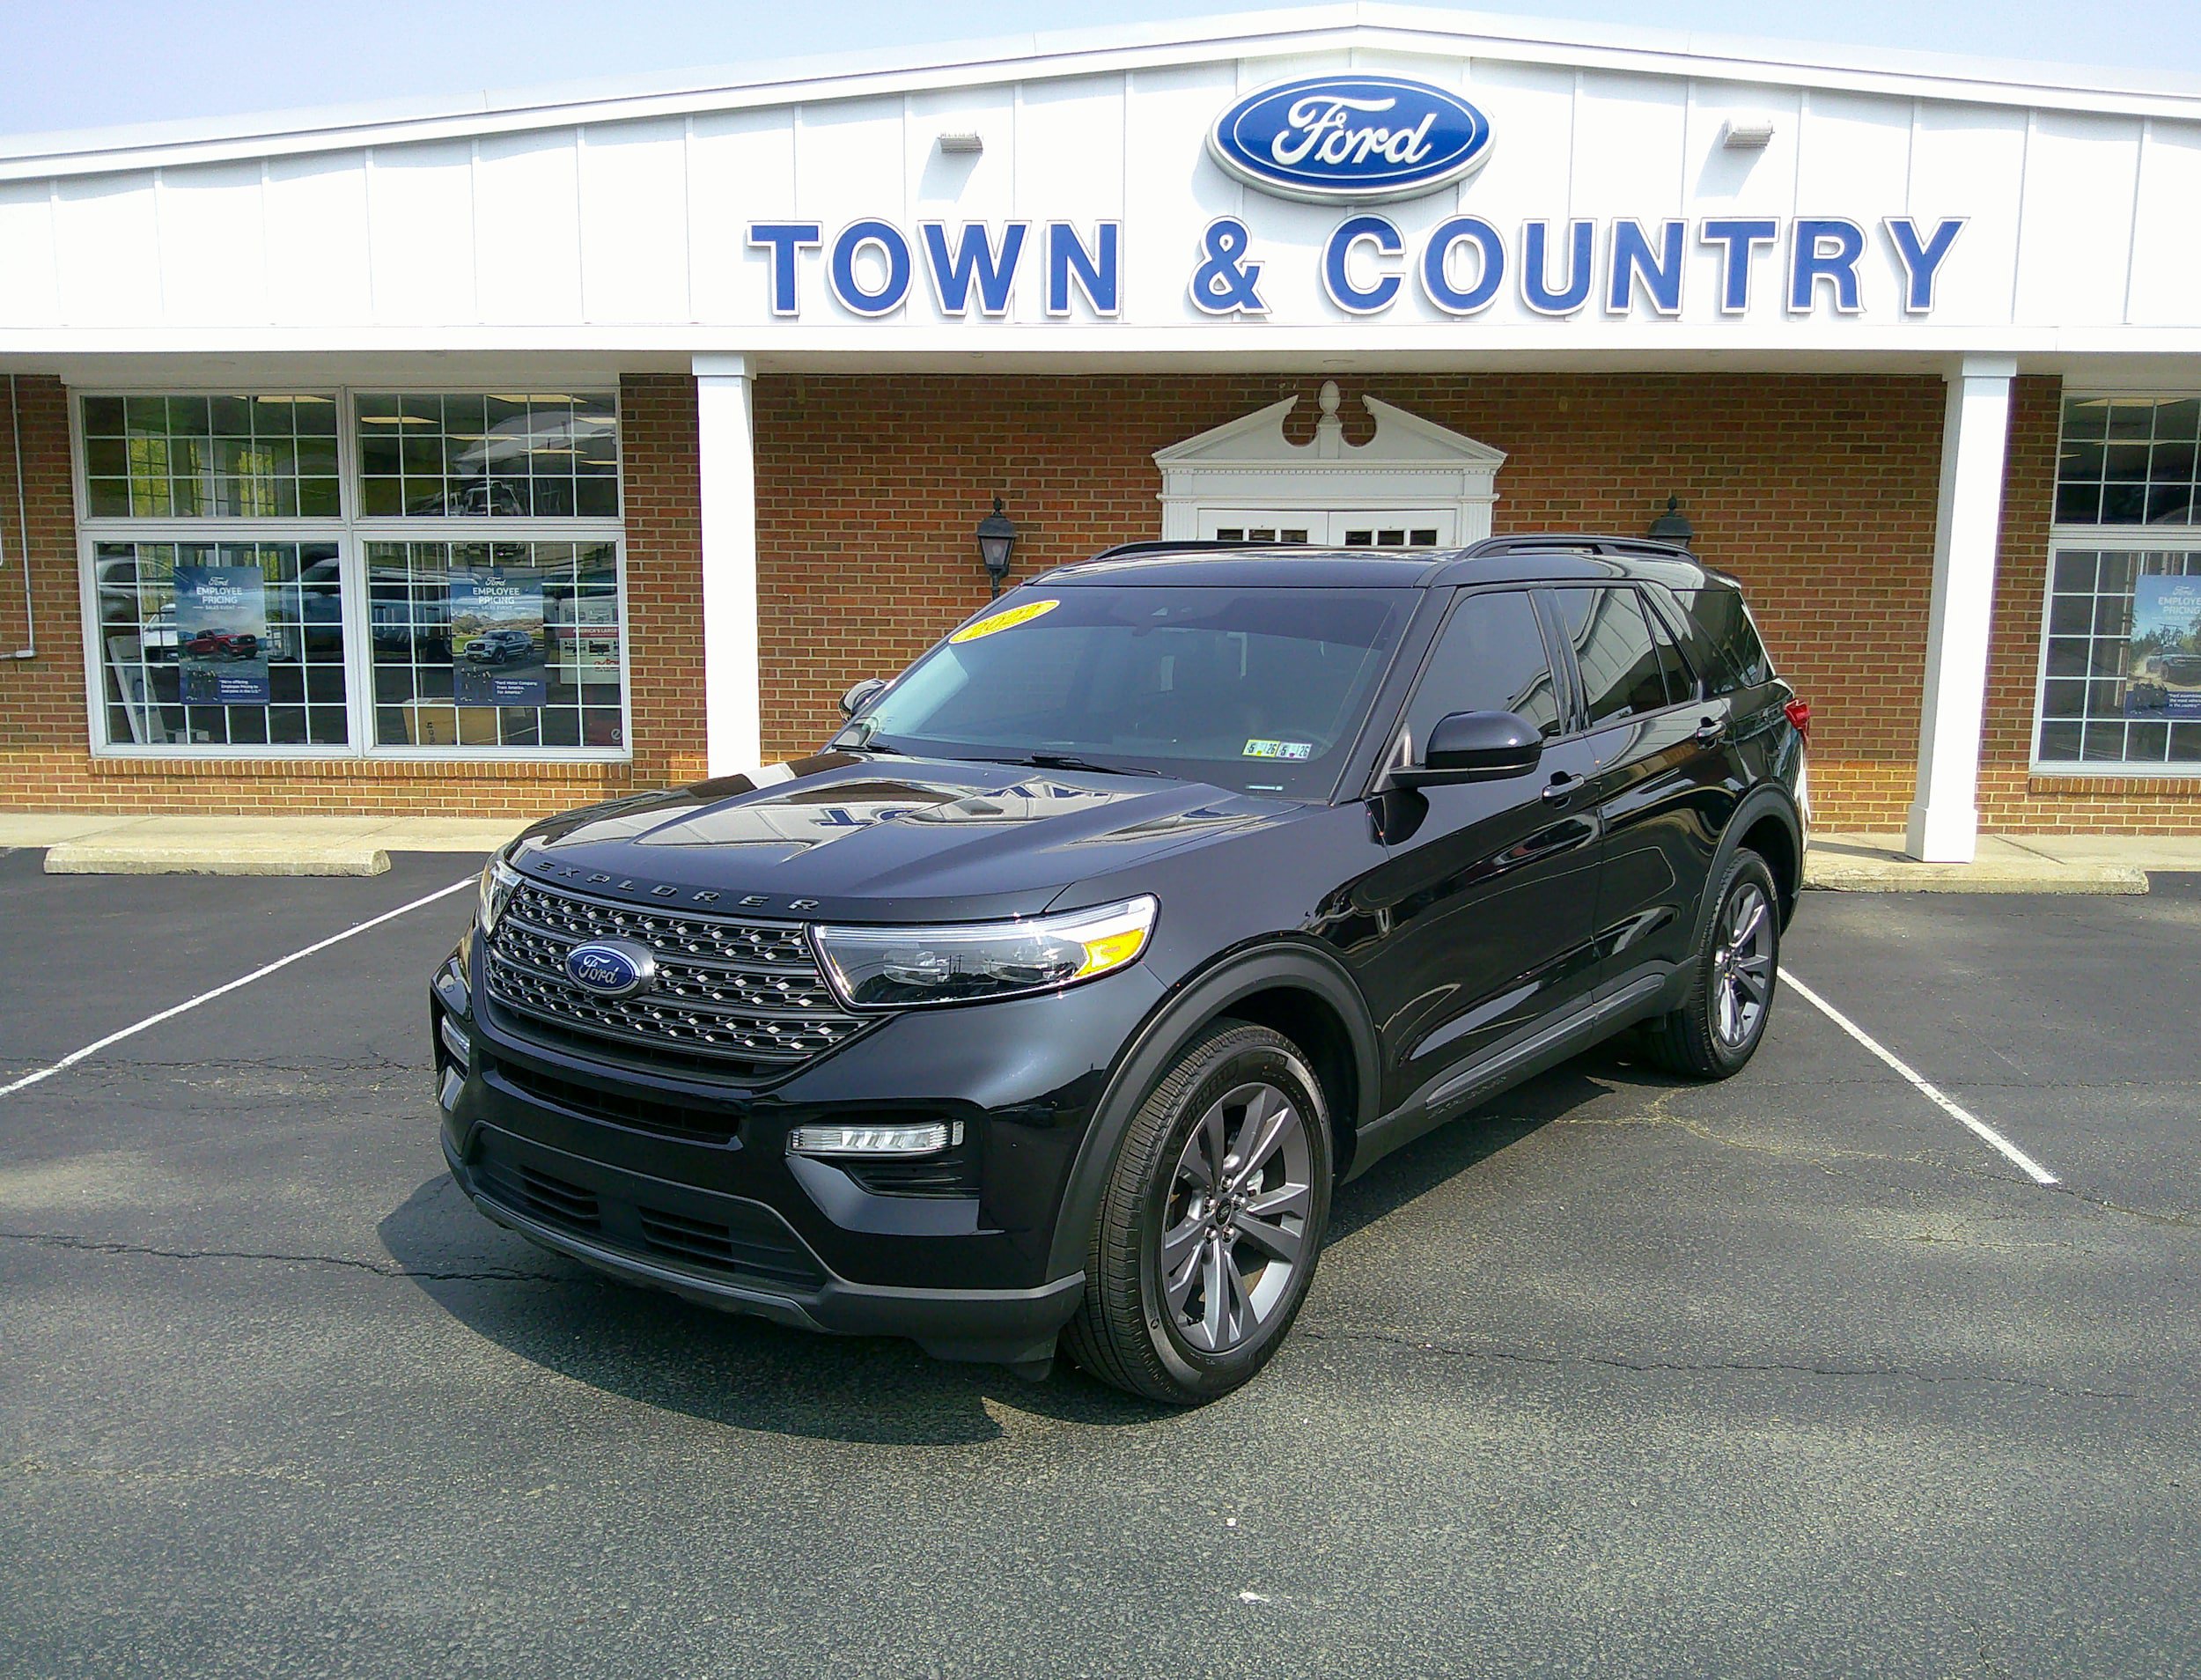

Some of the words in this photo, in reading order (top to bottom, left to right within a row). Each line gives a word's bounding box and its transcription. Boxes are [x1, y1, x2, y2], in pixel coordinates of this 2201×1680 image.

[1271, 95, 1437, 166] Ford
[747, 217, 1123, 317] TOWN
[1189, 214, 1273, 316] &
[1321, 212, 1971, 317] COUNTRY
[208, 576, 229, 586] Ford
[485, 576, 506, 586] Ford
[195, 586, 243, 595] EMPLOYEE
[202, 595, 238, 604] PRICING
[2162, 606, 2201, 615] PRICING
[534, 860, 820, 911] EXPLORER
[578, 954, 620, 984] Ford
